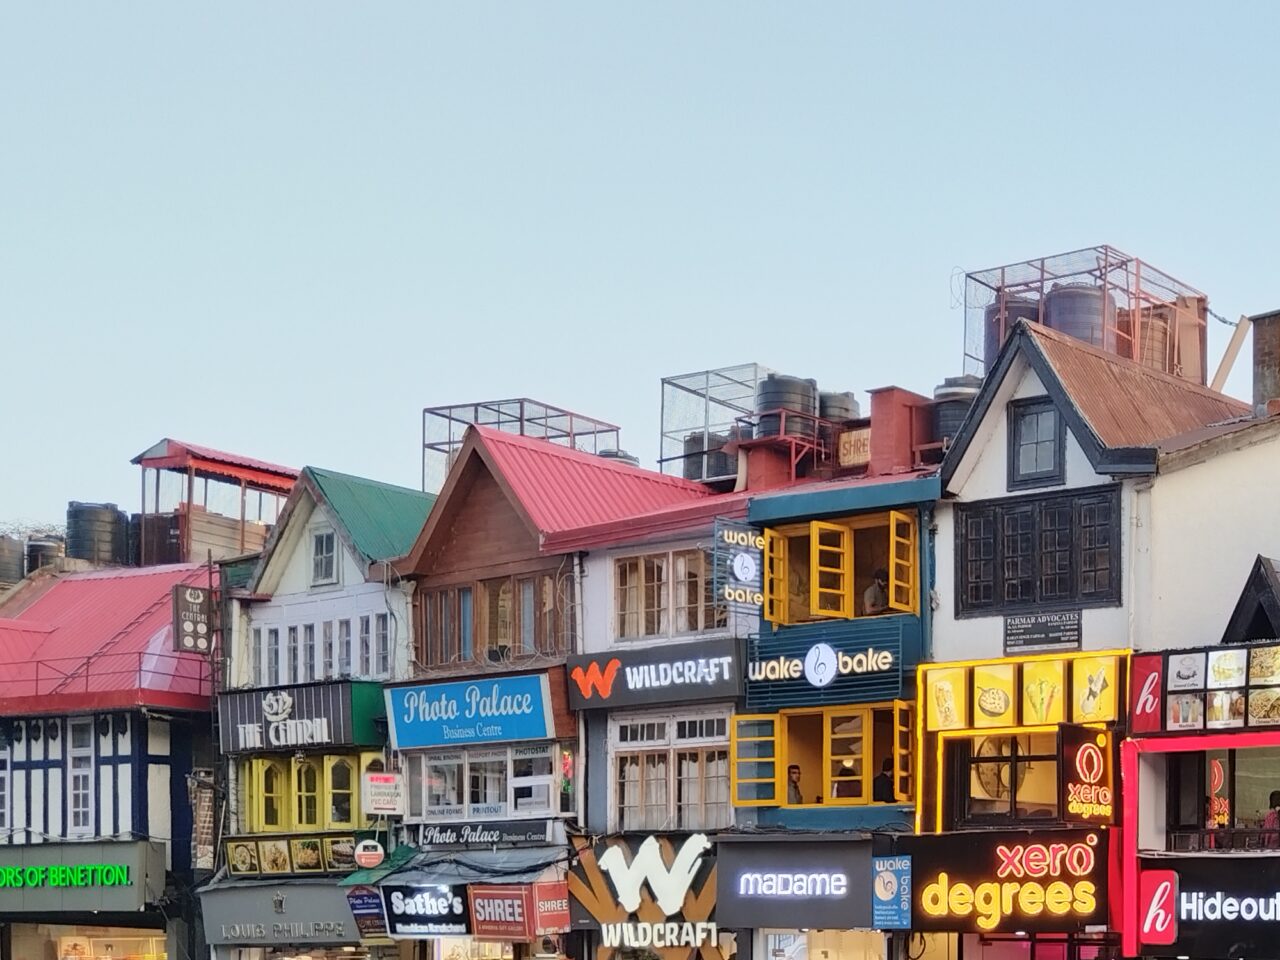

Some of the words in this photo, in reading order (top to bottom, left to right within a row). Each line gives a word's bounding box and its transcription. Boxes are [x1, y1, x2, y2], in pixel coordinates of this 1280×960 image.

[723, 529, 765, 549] wake
[724, 584, 764, 606] bake
[1006, 616, 1036, 626] PARMAR
[1037, 613, 1079, 624] ADVOCATES
[625, 655, 732, 690] WILDCRAFT
[748, 656, 803, 681] wake
[838, 647, 893, 674] bake
[403, 689, 460, 724] Photo
[465, 684, 533, 719] Palace
[237, 723, 264, 749] THE
[443, 725, 476, 740] Business
[476, 722, 503, 738] Centre
[515, 746, 549, 756] PHOTOSTAT
[1068, 782, 1112, 804] xero
[473, 805, 502, 814] PRINTOUT
[1068, 801, 1112, 819] degrees
[424, 827, 457, 844] Photo
[459, 824, 500, 843] Palace
[875, 857, 911, 872] wake
[25, 864, 48, 888] OF
[391, 891, 463, 915] Sathe's
[900, 875, 911, 911] bake
[921, 872, 1097, 930] degrees
[475, 898, 524, 922] SHREE
[538, 899, 569, 912] SHREE
[221, 922, 266, 940] LOUIS
[271, 920, 346, 939] PHILIPPE
[601, 922, 717, 948] WILDCRAFT
